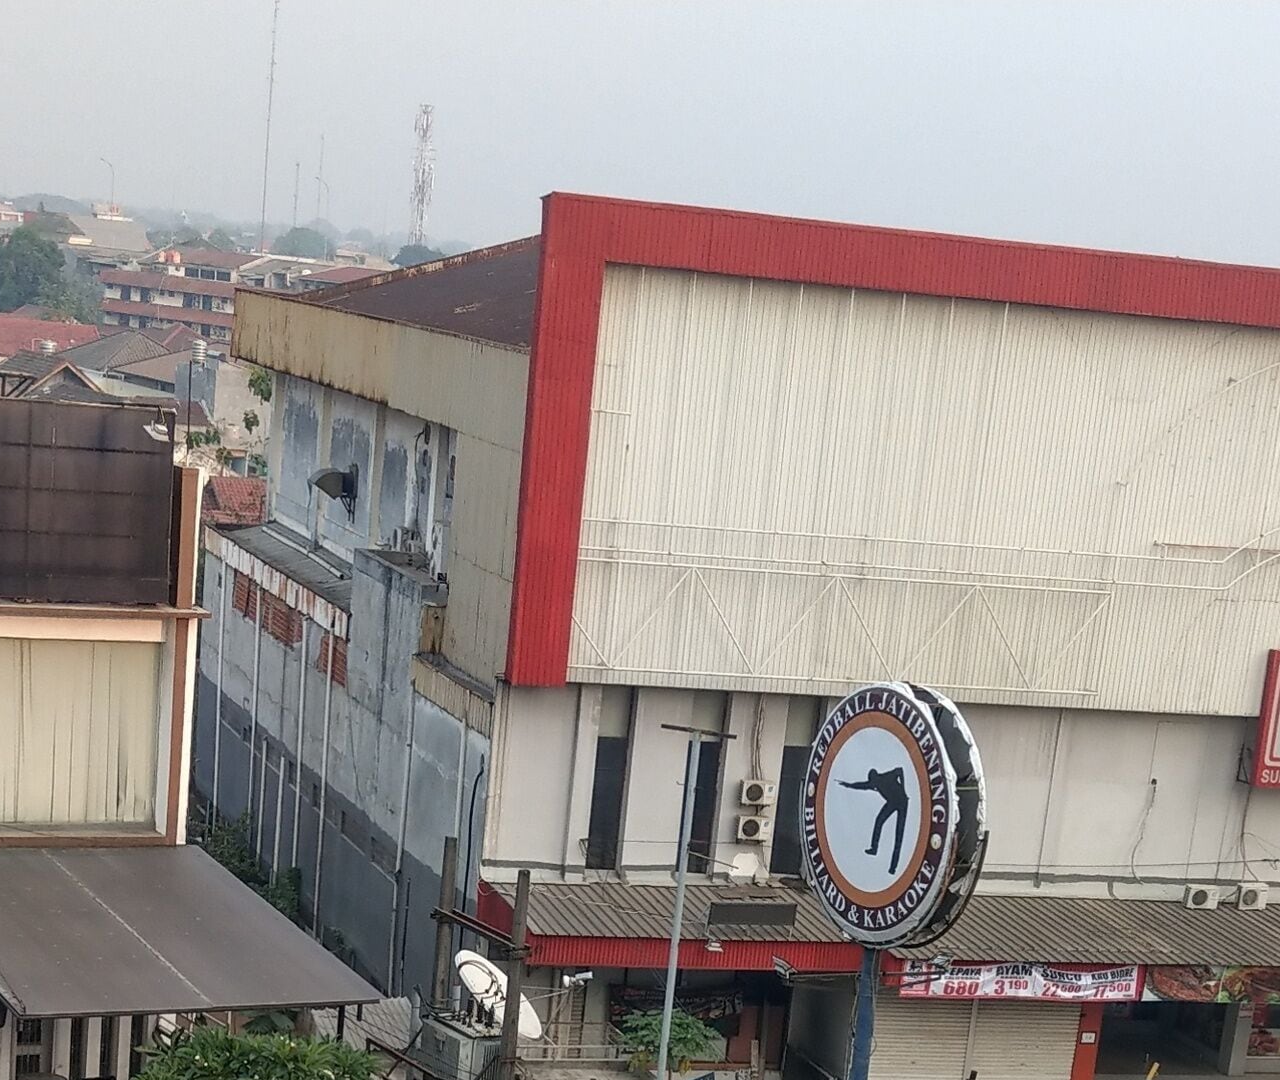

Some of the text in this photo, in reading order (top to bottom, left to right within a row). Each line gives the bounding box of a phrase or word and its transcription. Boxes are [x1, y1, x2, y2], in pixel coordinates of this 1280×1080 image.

[812, 691, 946, 824] REDBALL JATIBENING
[804, 807, 935, 928] BILLIARD & KARAOKE
[943, 980, 980, 995] 680
[996, 962, 1034, 977] AYAM
